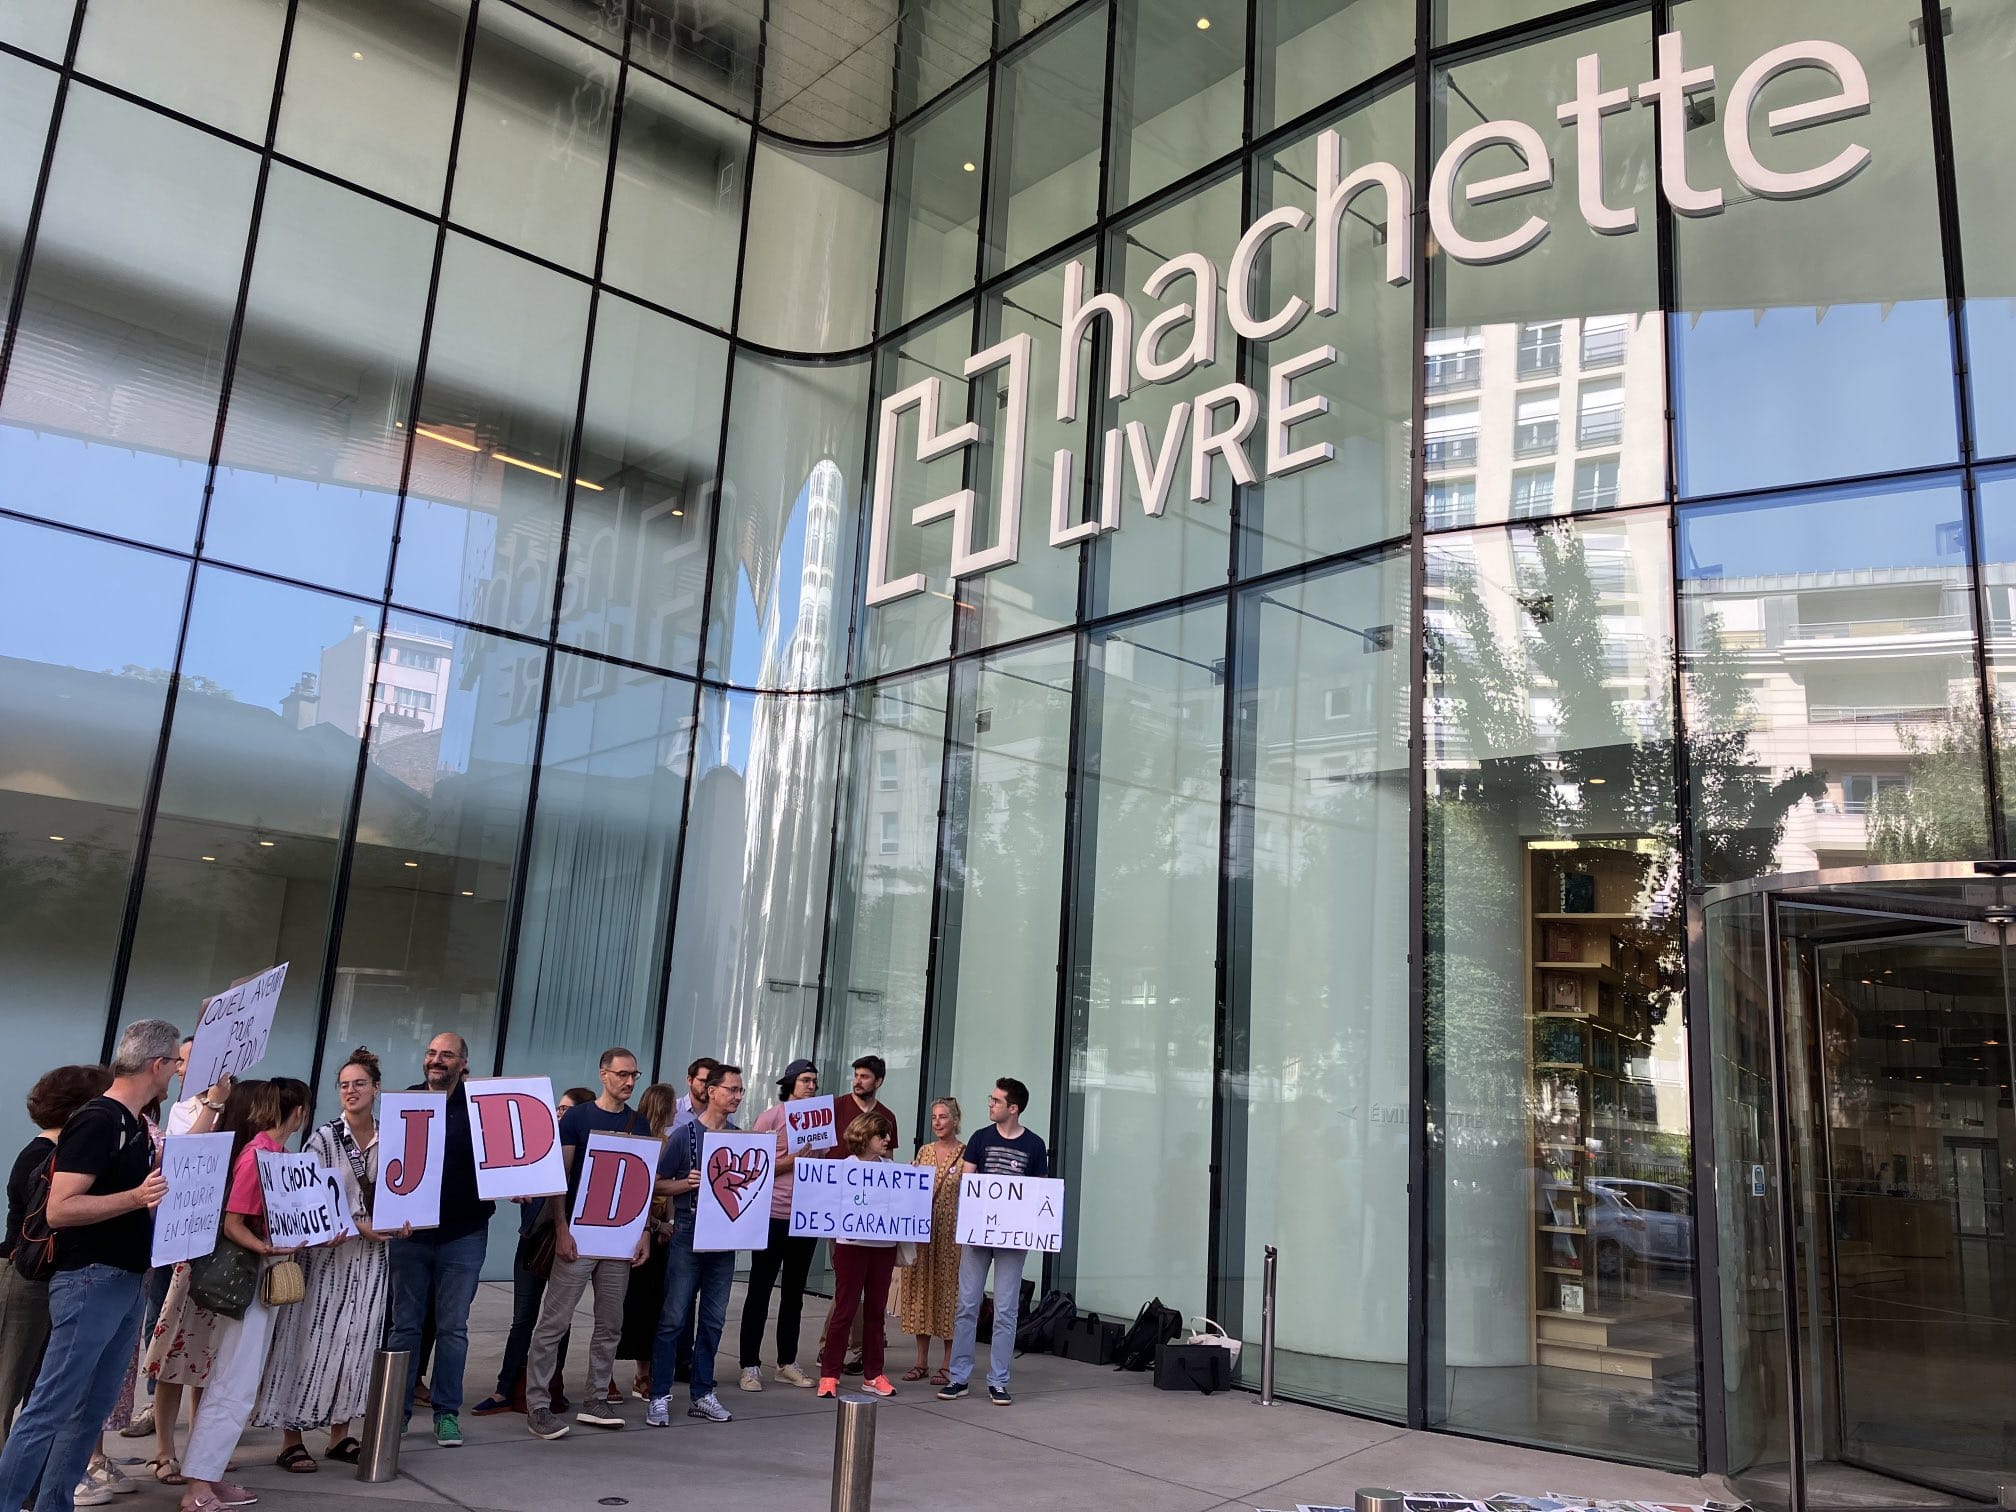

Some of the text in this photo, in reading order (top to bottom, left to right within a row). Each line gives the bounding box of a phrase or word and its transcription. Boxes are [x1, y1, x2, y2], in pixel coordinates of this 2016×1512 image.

[1056, 29, 1873, 425] hachette
[1048, 344, 1338, 550] LIVRE
[204, 986, 245, 1026] QUEL
[471, 1092, 555, 1170] D
[801, 1107, 833, 1130] JDD
[385, 1109, 435, 1196] J
[797, 1136, 806, 1145] EN
[573, 1149, 651, 1228] D
[798, 1162, 930, 1191] UNE CHARTE
[173, 1184, 215, 1210] MOURIR
[854, 1189, 869, 1206] et
[967, 1180, 1055, 1218] NON À
[163, 1222, 180, 1242] EN
[795, 1211, 836, 1232] DES
[966, 1228, 1061, 1251] LEJEUNE
